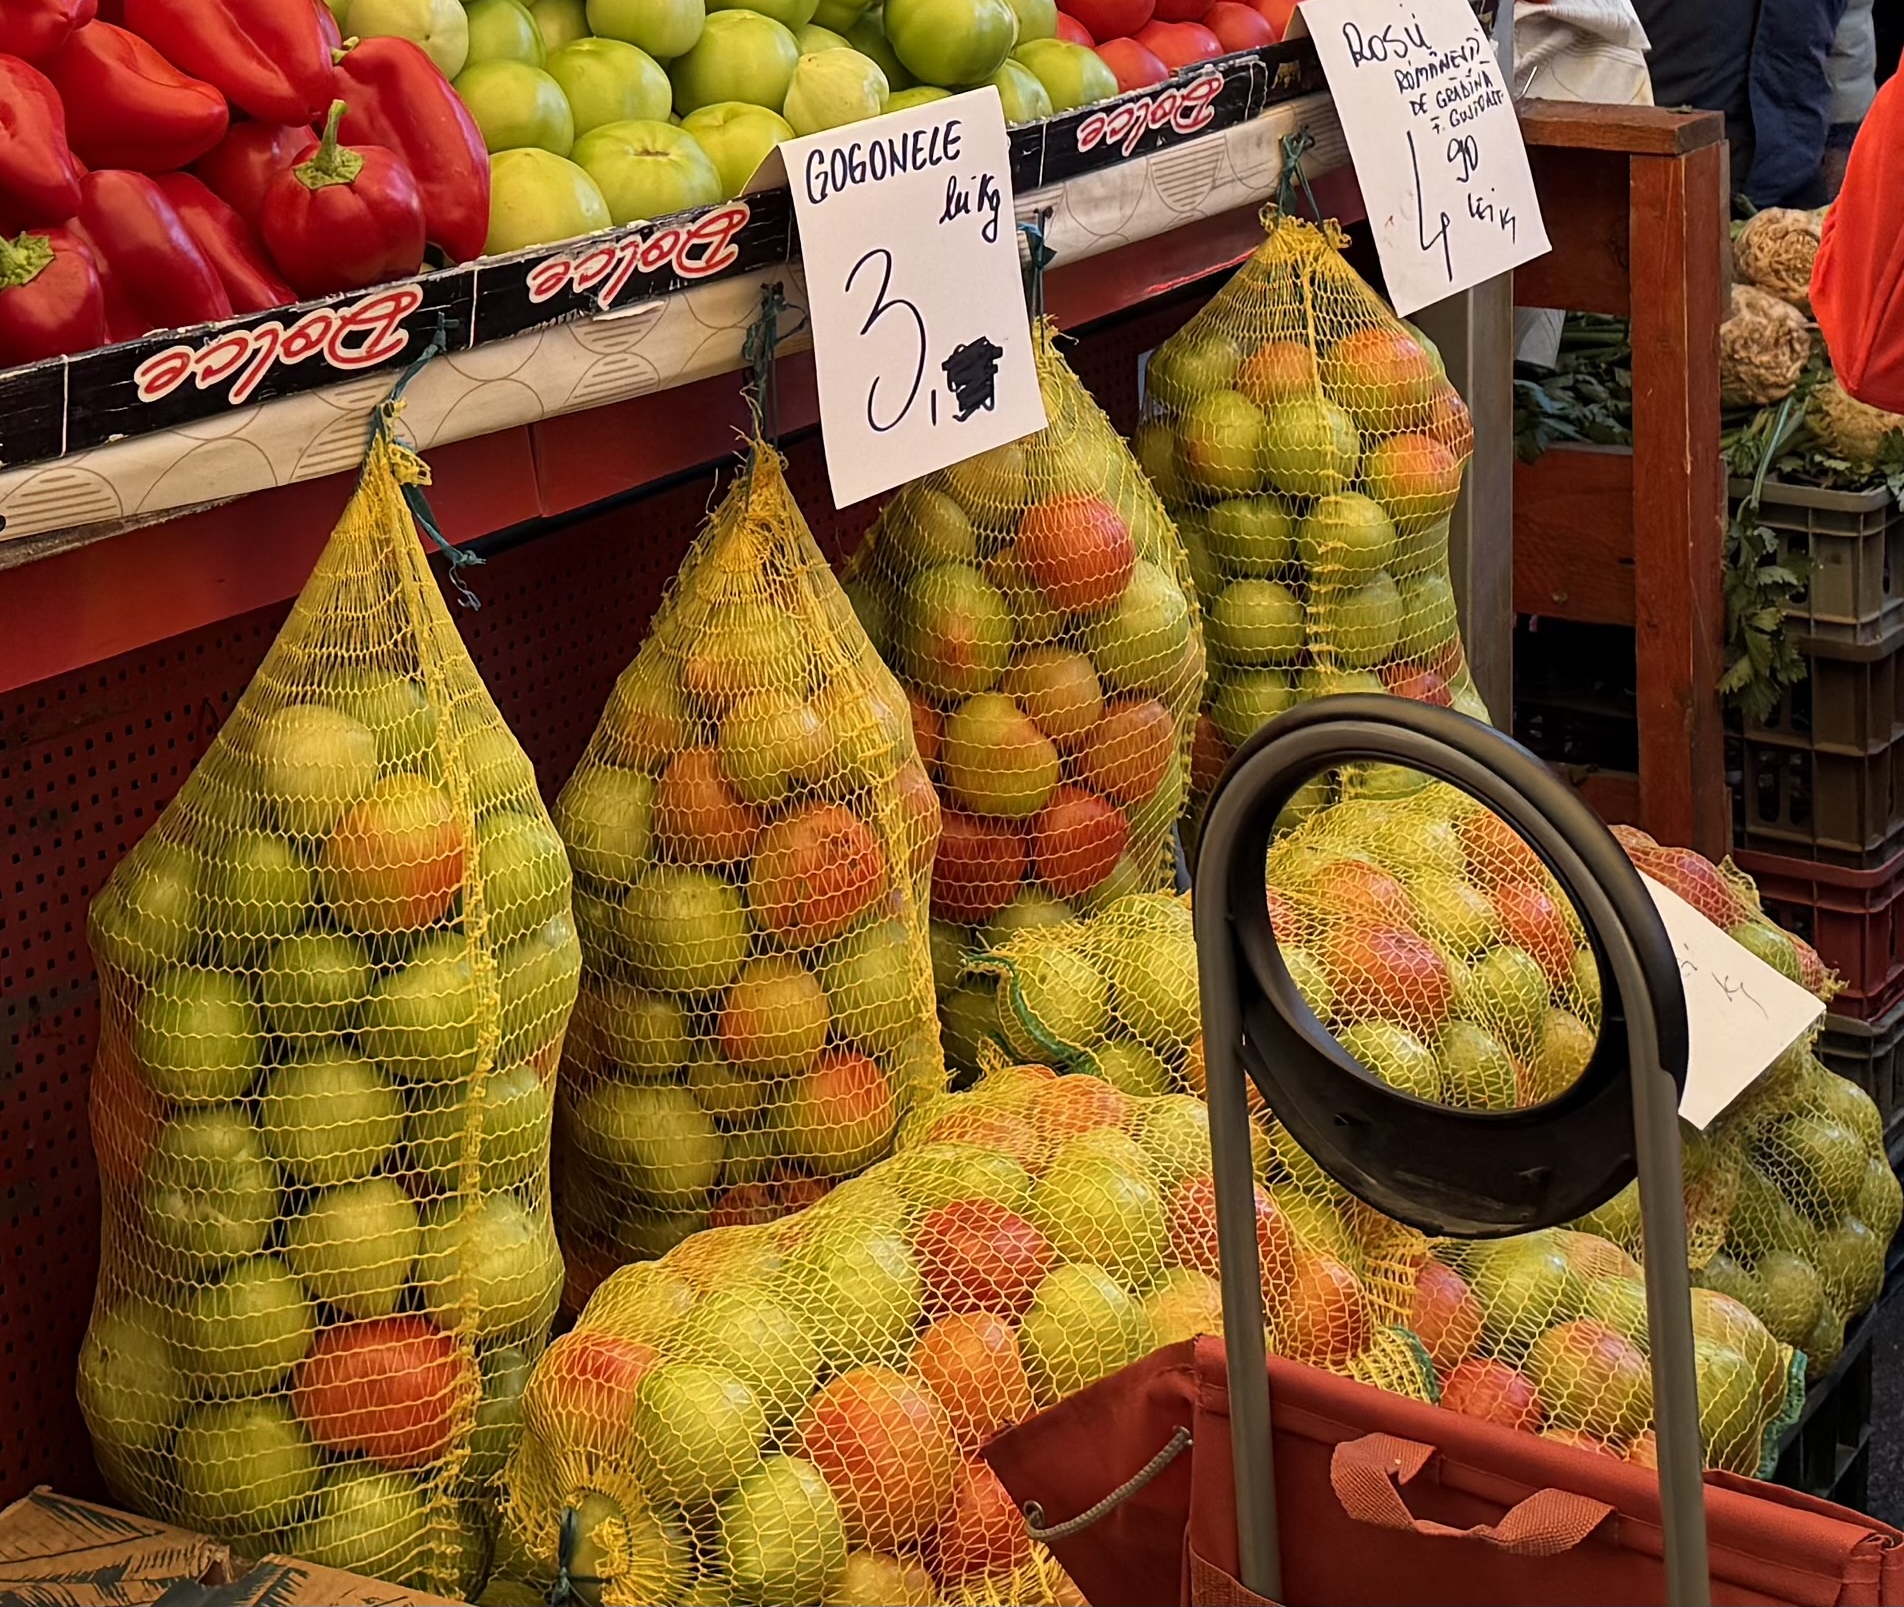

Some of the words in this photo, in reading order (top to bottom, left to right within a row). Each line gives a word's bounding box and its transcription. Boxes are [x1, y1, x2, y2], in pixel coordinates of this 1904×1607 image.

[1077, 71, 1224, 157] Dolce
[1409, 92, 1429, 116] DE
[805, 120, 962, 205] GOGONELE
[1446, 134, 1479, 183] 90
[1406, 129, 1453, 283] 4
[526, 200, 751, 311] Dolce
[134, 284, 424, 405] Dolce
